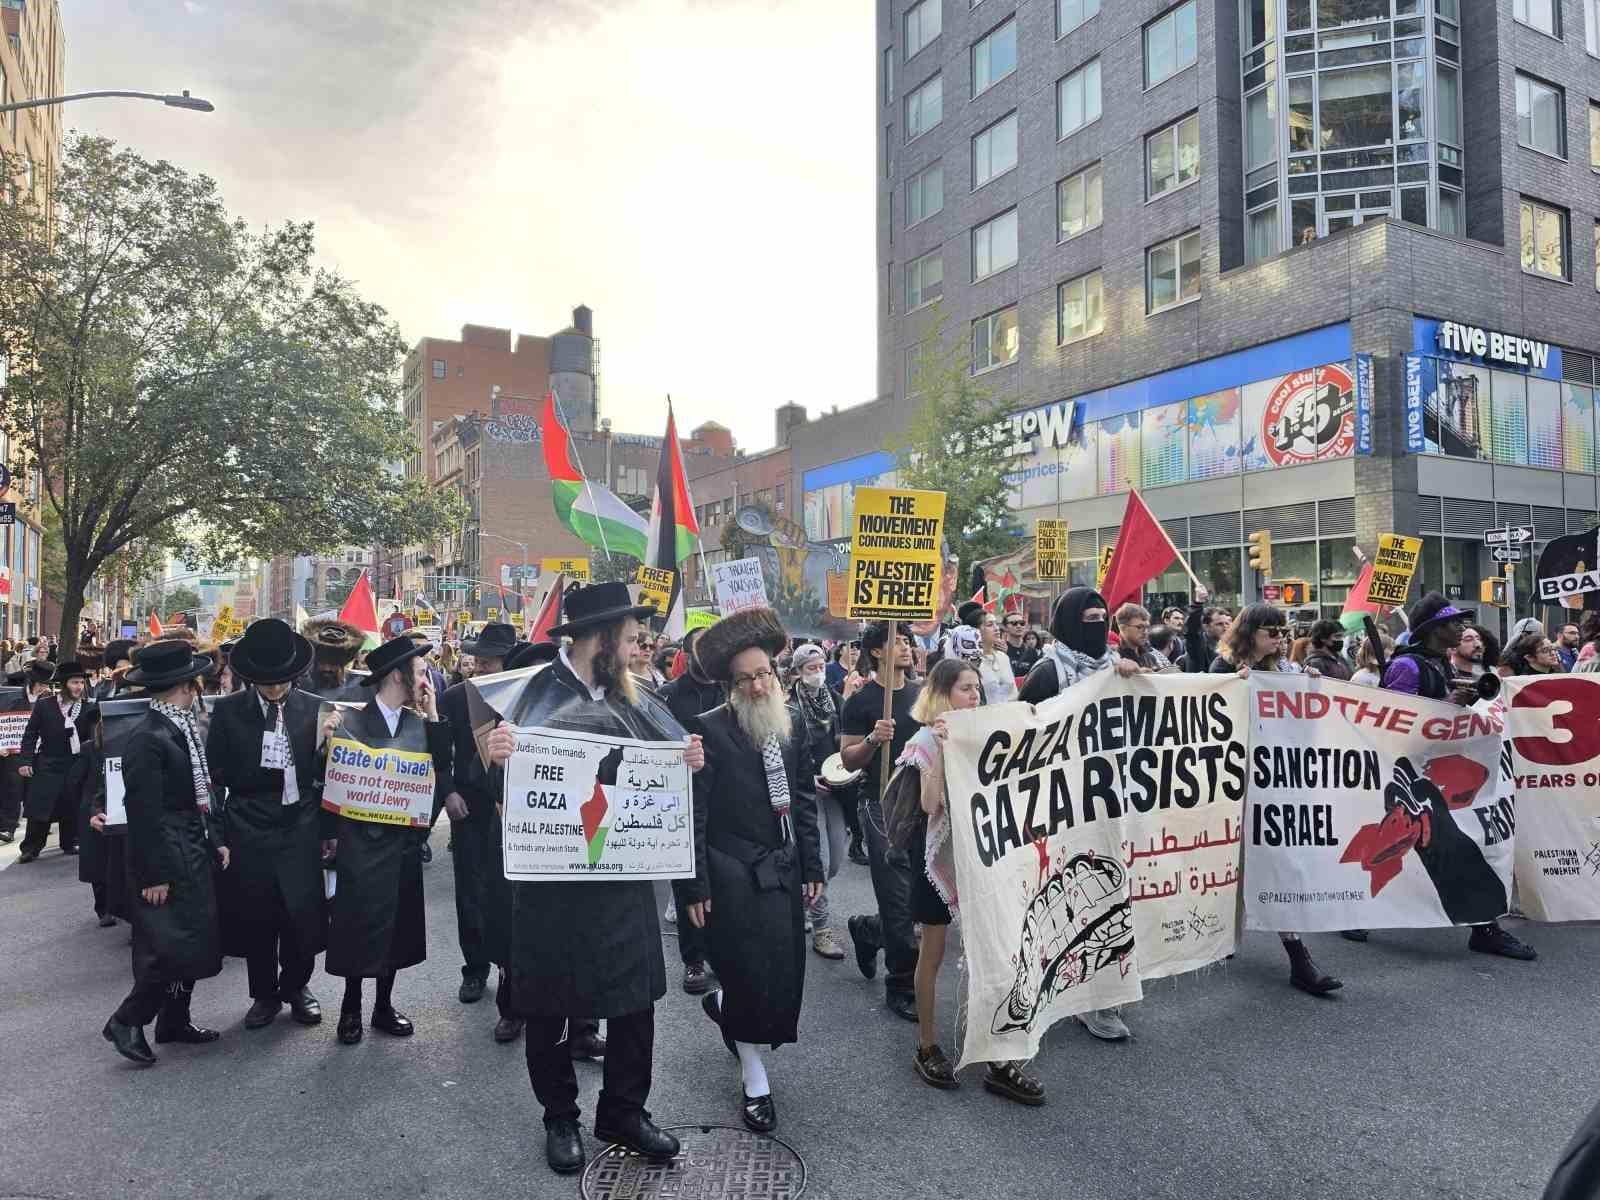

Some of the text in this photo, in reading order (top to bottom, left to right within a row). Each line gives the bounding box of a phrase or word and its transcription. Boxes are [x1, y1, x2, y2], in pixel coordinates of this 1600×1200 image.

[1442, 321, 1549, 369] five BELOW
[1408, 411, 1421, 449] five
[889, 496, 915, 515] THE
[859, 515, 939, 536] MOVEMENT
[859, 535, 936, 551] CONTINUES UNTIL
[1038, 538, 1056, 550] END
[1391, 537, 1406, 550] THE
[642, 567, 670, 585] FREE
[856, 559, 936, 581] PALESTINE
[1038, 559, 1067, 576] NOW!
[854, 580, 933, 607] IS FREE!
[1377, 582, 1407, 601] FREE!
[1542, 574, 1600, 596] BOA
[1256, 690, 1331, 720] END
[1332, 695, 1419, 735] THE
[516, 741, 587, 759] Judaism Demands
[977, 692, 1234, 787] GAZA REMAINS
[331, 745, 372, 769] State
[374, 753, 388, 771] of
[1253, 745, 1382, 790] SANCTION
[327, 768, 433, 797] does not represent
[533, 764, 565, 782] FREE
[627, 768, 669, 793] الحرية
[1514, 772, 1600, 790] YEARS O
[346, 789, 411, 811] world Jewry
[526, 790, 568, 811] GAZA
[615, 813, 663, 833] فلسطين
[970, 768, 1076, 868] GAZA
[1252, 803, 1339, 847] ISRAEL
[507, 822, 584, 837] And ALL PALESTINE
[1534, 850, 1578, 859] PALESTINIAN
[567, 861, 623, 872] www.nkusa.org
[1543, 866, 1580, 877] MOVEMENT
